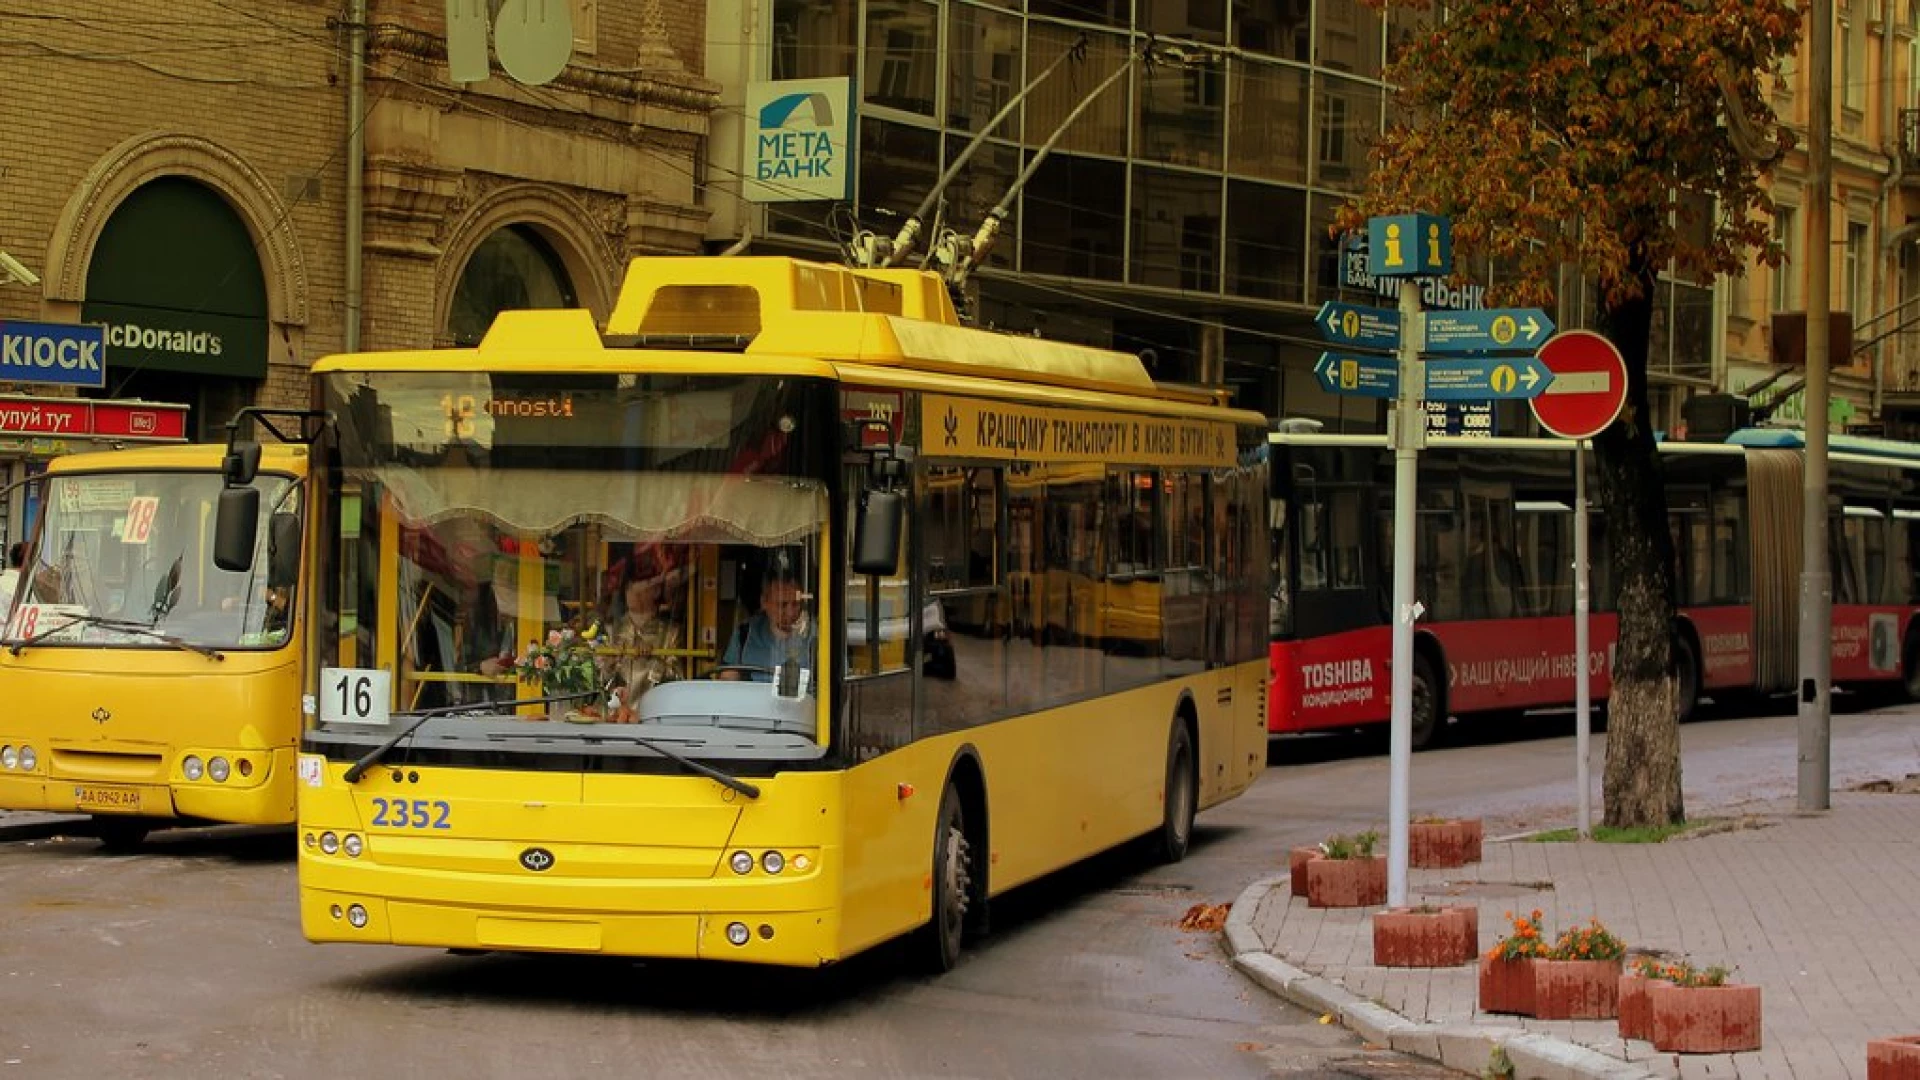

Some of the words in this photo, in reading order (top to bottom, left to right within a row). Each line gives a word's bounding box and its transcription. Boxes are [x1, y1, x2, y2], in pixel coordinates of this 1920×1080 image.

[758, 131, 833, 158] МЕТА
[758, 157, 833, 181] БАНК
[1347, 252, 1371, 272] МЕТ
[46, 411, 73, 432] тут
[976, 410, 1048, 456] КРАЩОМУ
[1052, 419, 1128, 454] ТРАНСПОРТУ
[1132, 422, 1140, 453] В
[127, 499, 157, 541] 18
[16, 605, 40, 640] 18
[1302, 658, 1373, 690] TOSHIBA
[1461, 661, 1492, 686] ВАШ
[1494, 651, 1549, 686] КРАЩИЙ
[1551, 653, 1605, 679] ІНВЕОР
[336, 674, 372, 718] 16
[371, 797, 452, 829] 2352
